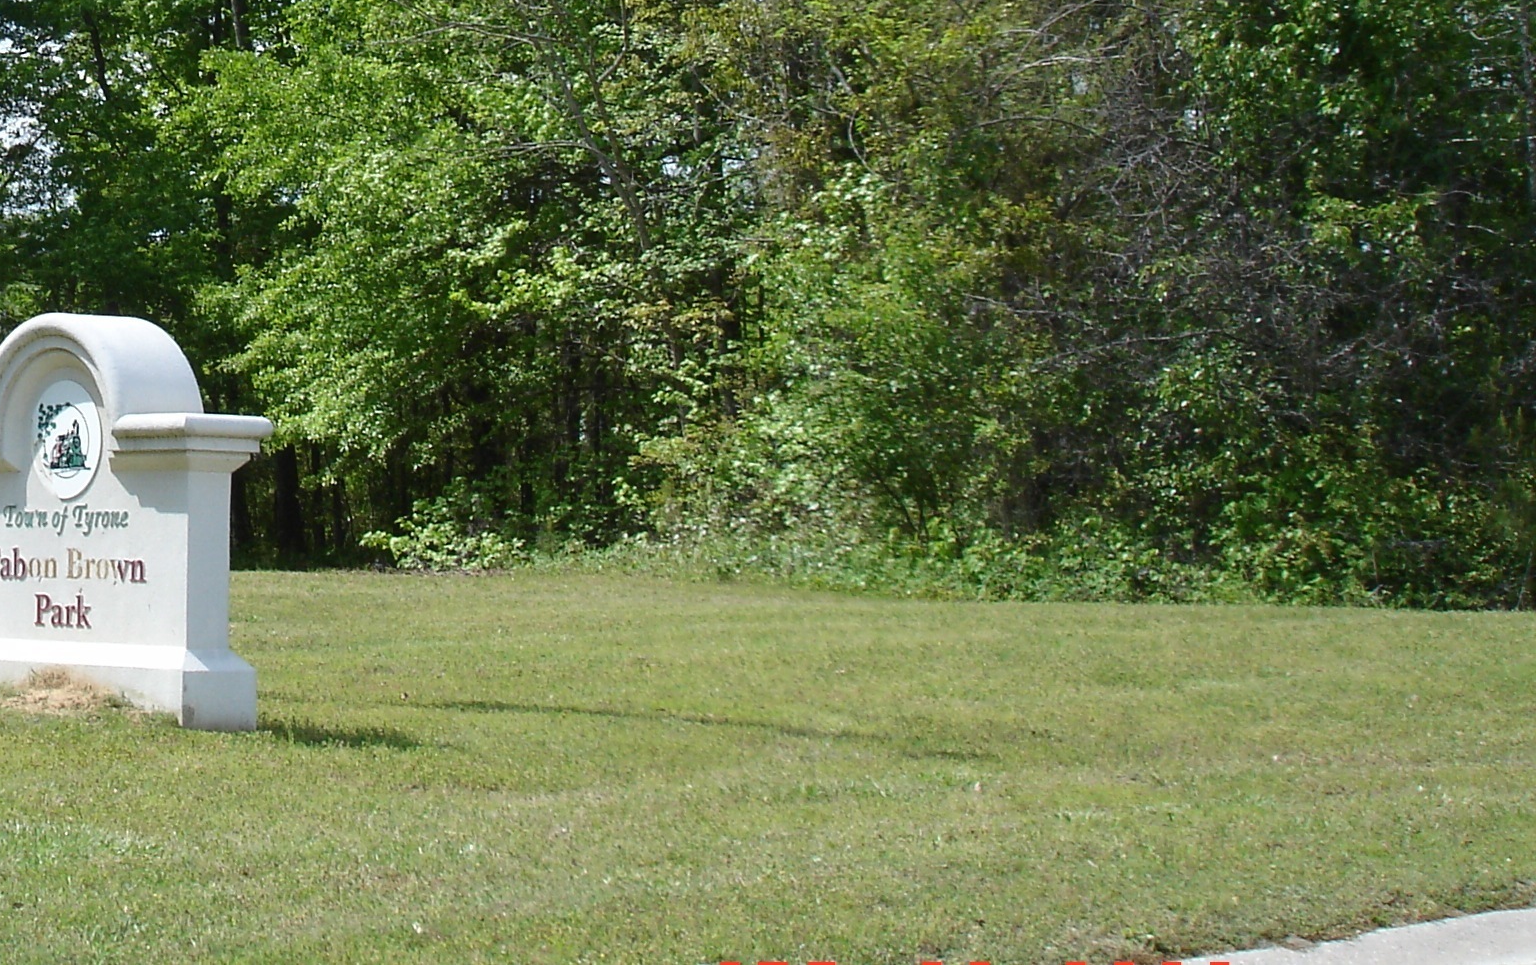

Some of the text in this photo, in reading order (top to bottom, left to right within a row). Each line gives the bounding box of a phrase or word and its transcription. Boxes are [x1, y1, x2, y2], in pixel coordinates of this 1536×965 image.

[3, 504, 129, 536] Town of Tyrone
[66, 547, 147, 584] Brown
[34, 592, 92, 629] Park
